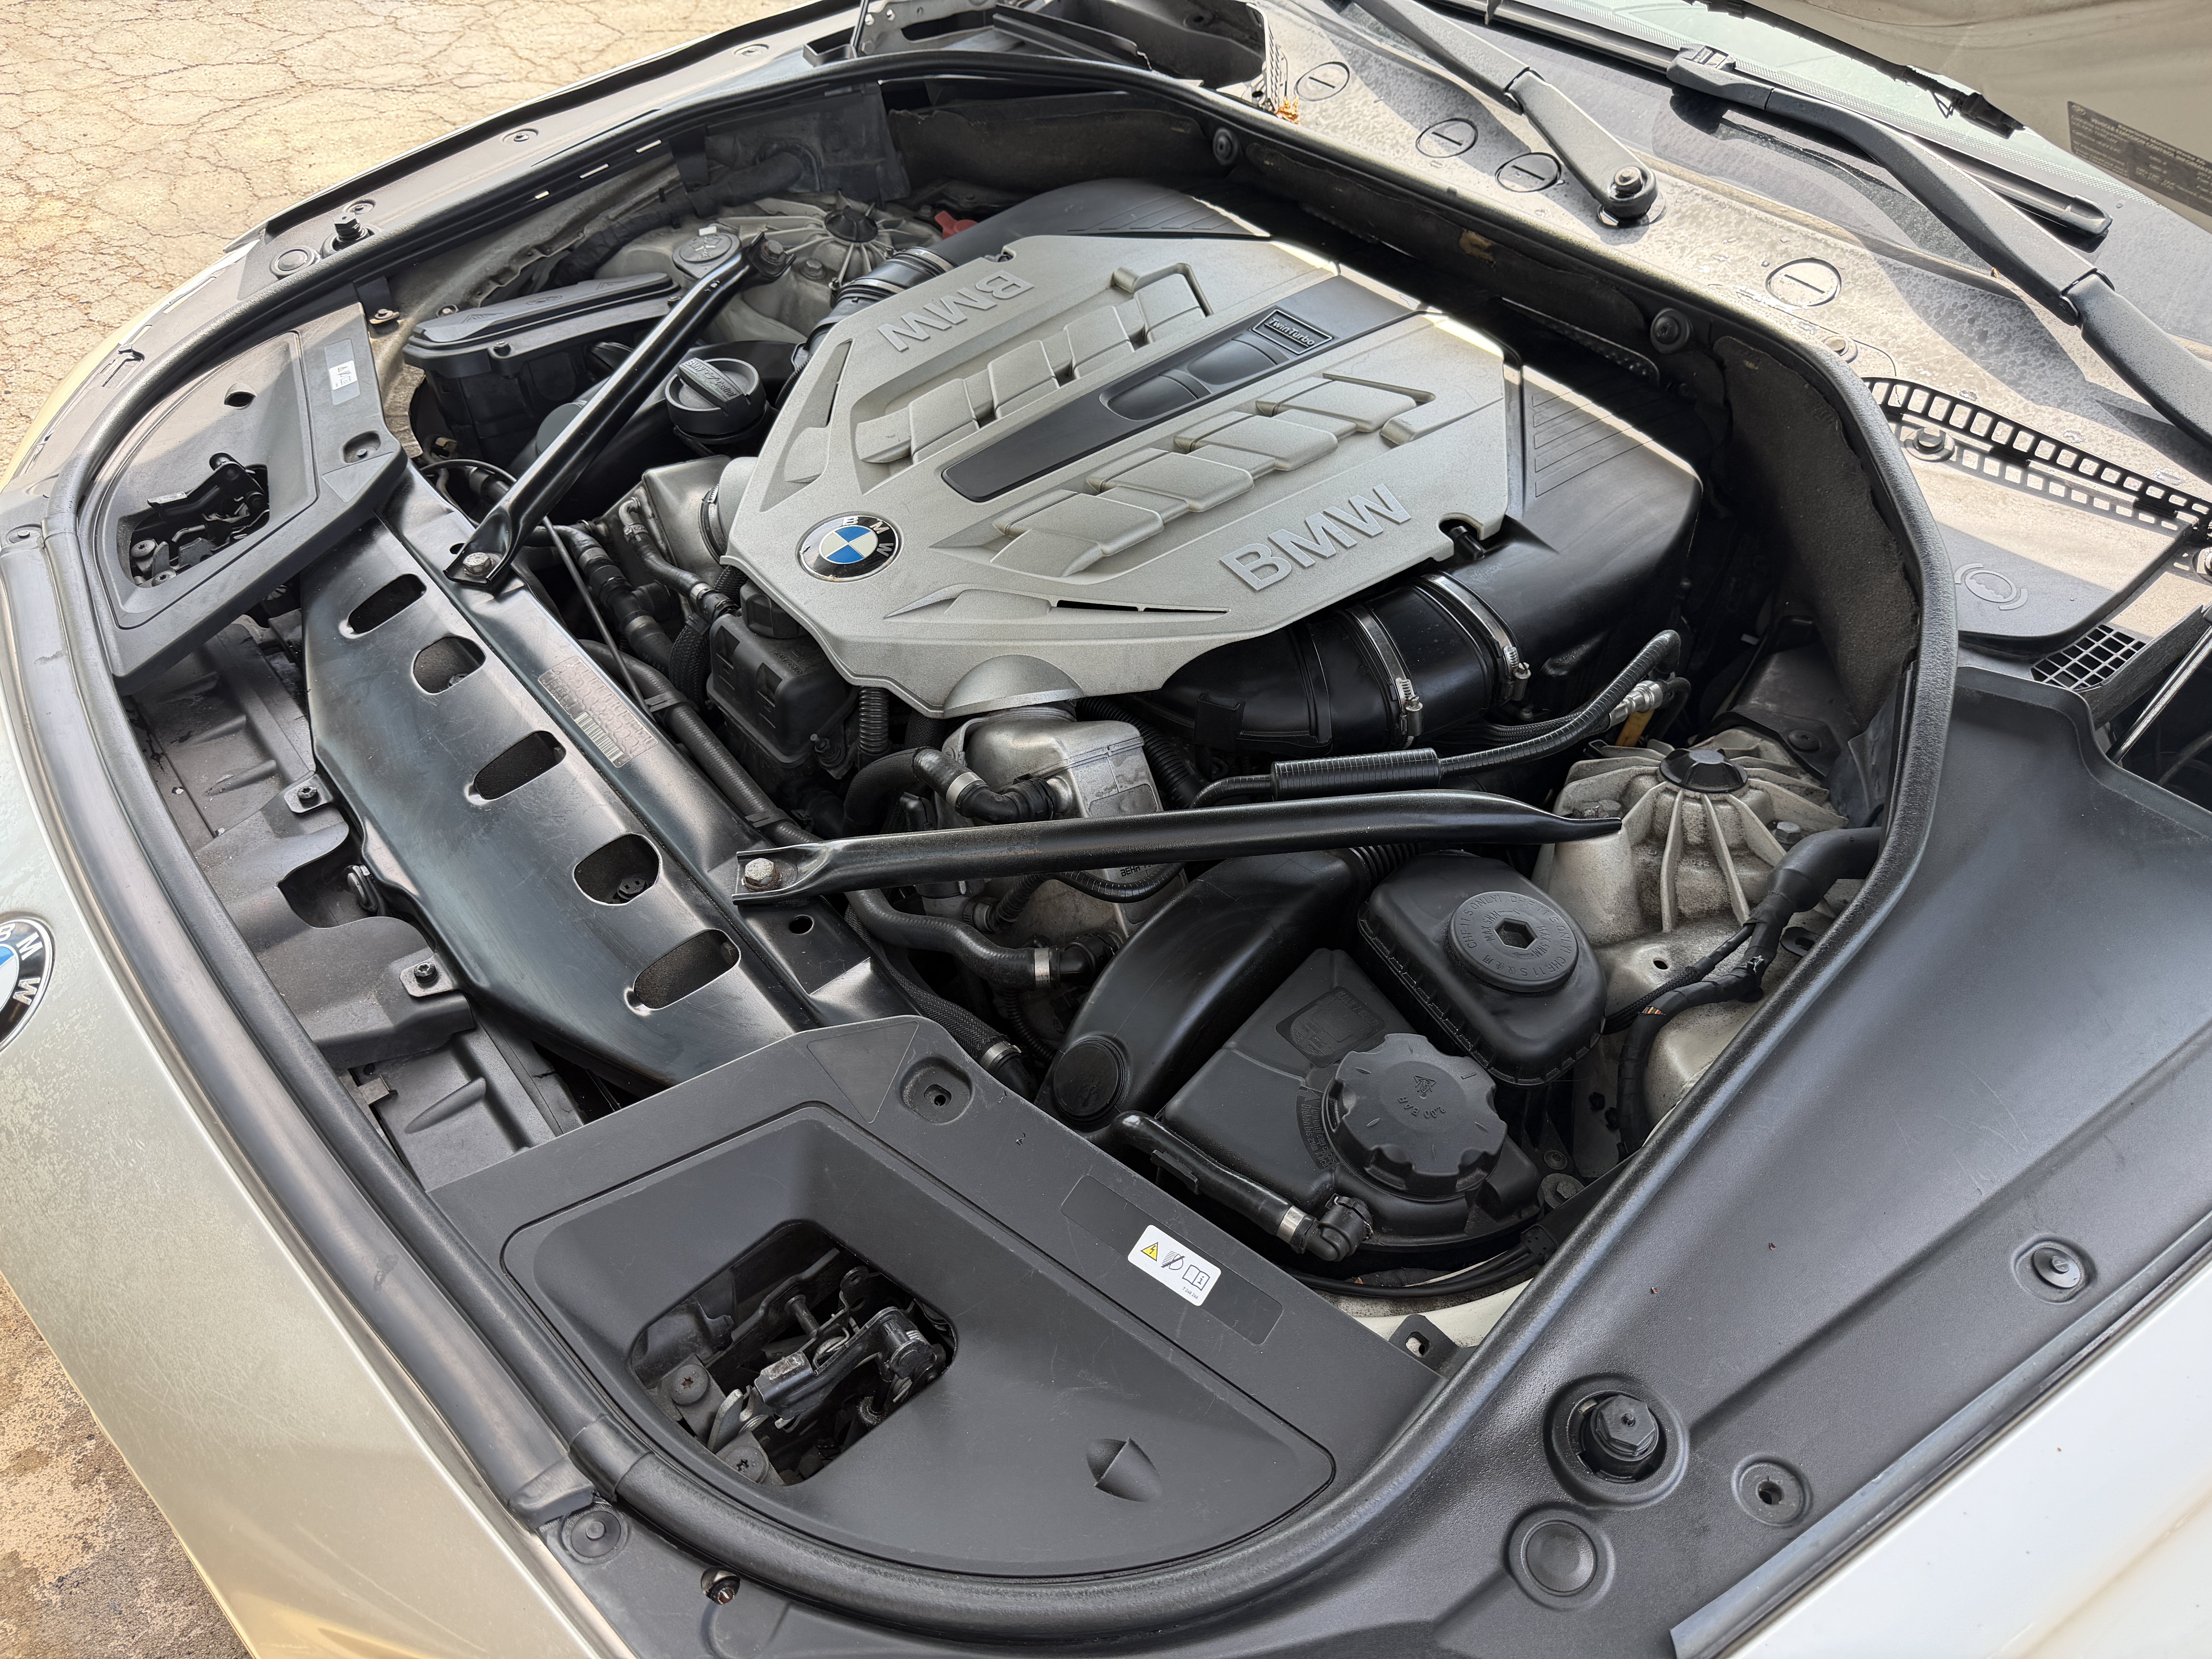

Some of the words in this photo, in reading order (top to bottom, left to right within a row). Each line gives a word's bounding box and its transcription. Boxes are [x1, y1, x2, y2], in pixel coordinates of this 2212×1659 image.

[878, 270, 1035, 352] BMW
[1268, 318, 1315, 346] TwinTurbo
[686, 361, 704, 372] BMW
[716, 380, 737, 397] Castrol
[843, 516, 894, 557] BMW
[1219, 483, 1411, 591] BMW
[1510, 896, 1535, 908] CHF
[1460, 930, 1477, 948] CHF
[1480, 925, 1495, 941] MAX
[1536, 926, 1551, 942] MAX
[1520, 968, 1528, 977] S
[1548, 957, 1566, 974] CHF
[1301, 1104, 1312, 1125] Drehen
[1397, 1096, 1420, 1117] BAR
[1423, 1106, 1446, 1119] 2.00
[1304, 1127, 1314, 1137] bis
